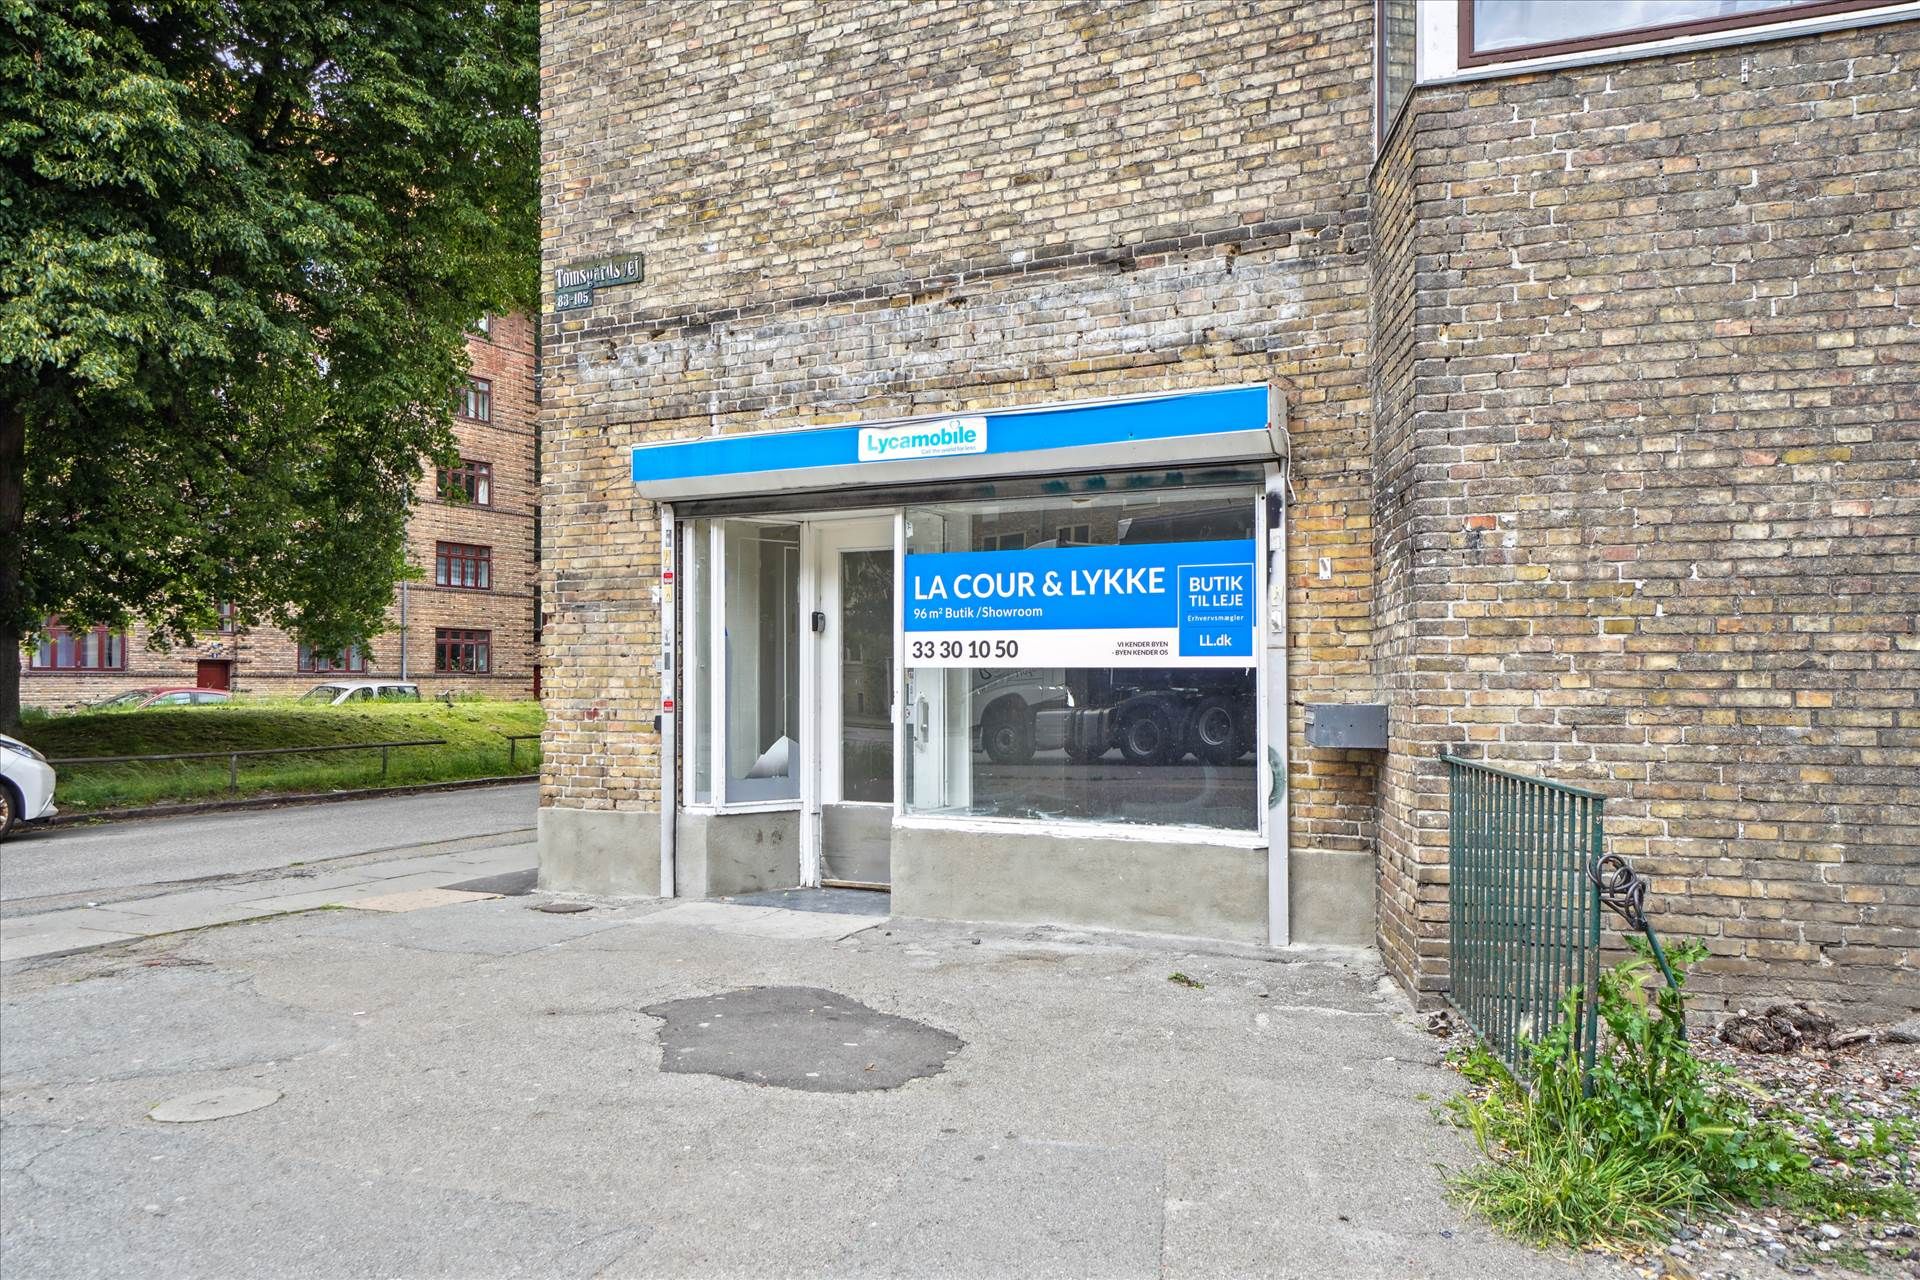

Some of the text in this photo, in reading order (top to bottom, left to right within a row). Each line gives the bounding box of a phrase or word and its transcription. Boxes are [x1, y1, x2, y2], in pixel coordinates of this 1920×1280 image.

[557, 290, 590, 308] 83-105
[867, 425, 977, 454] Lycamobile
[914, 567, 1166, 600] LA COUR & LYKKE
[1189, 575, 1244, 592] BUTIK
[1189, 593, 1243, 607] TIL LEJE
[913, 608, 927, 619] 96
[945, 606, 974, 619] Butik
[1199, 633, 1232, 647] LL.dk
[912, 639, 1019, 659] 33 30 10 50
